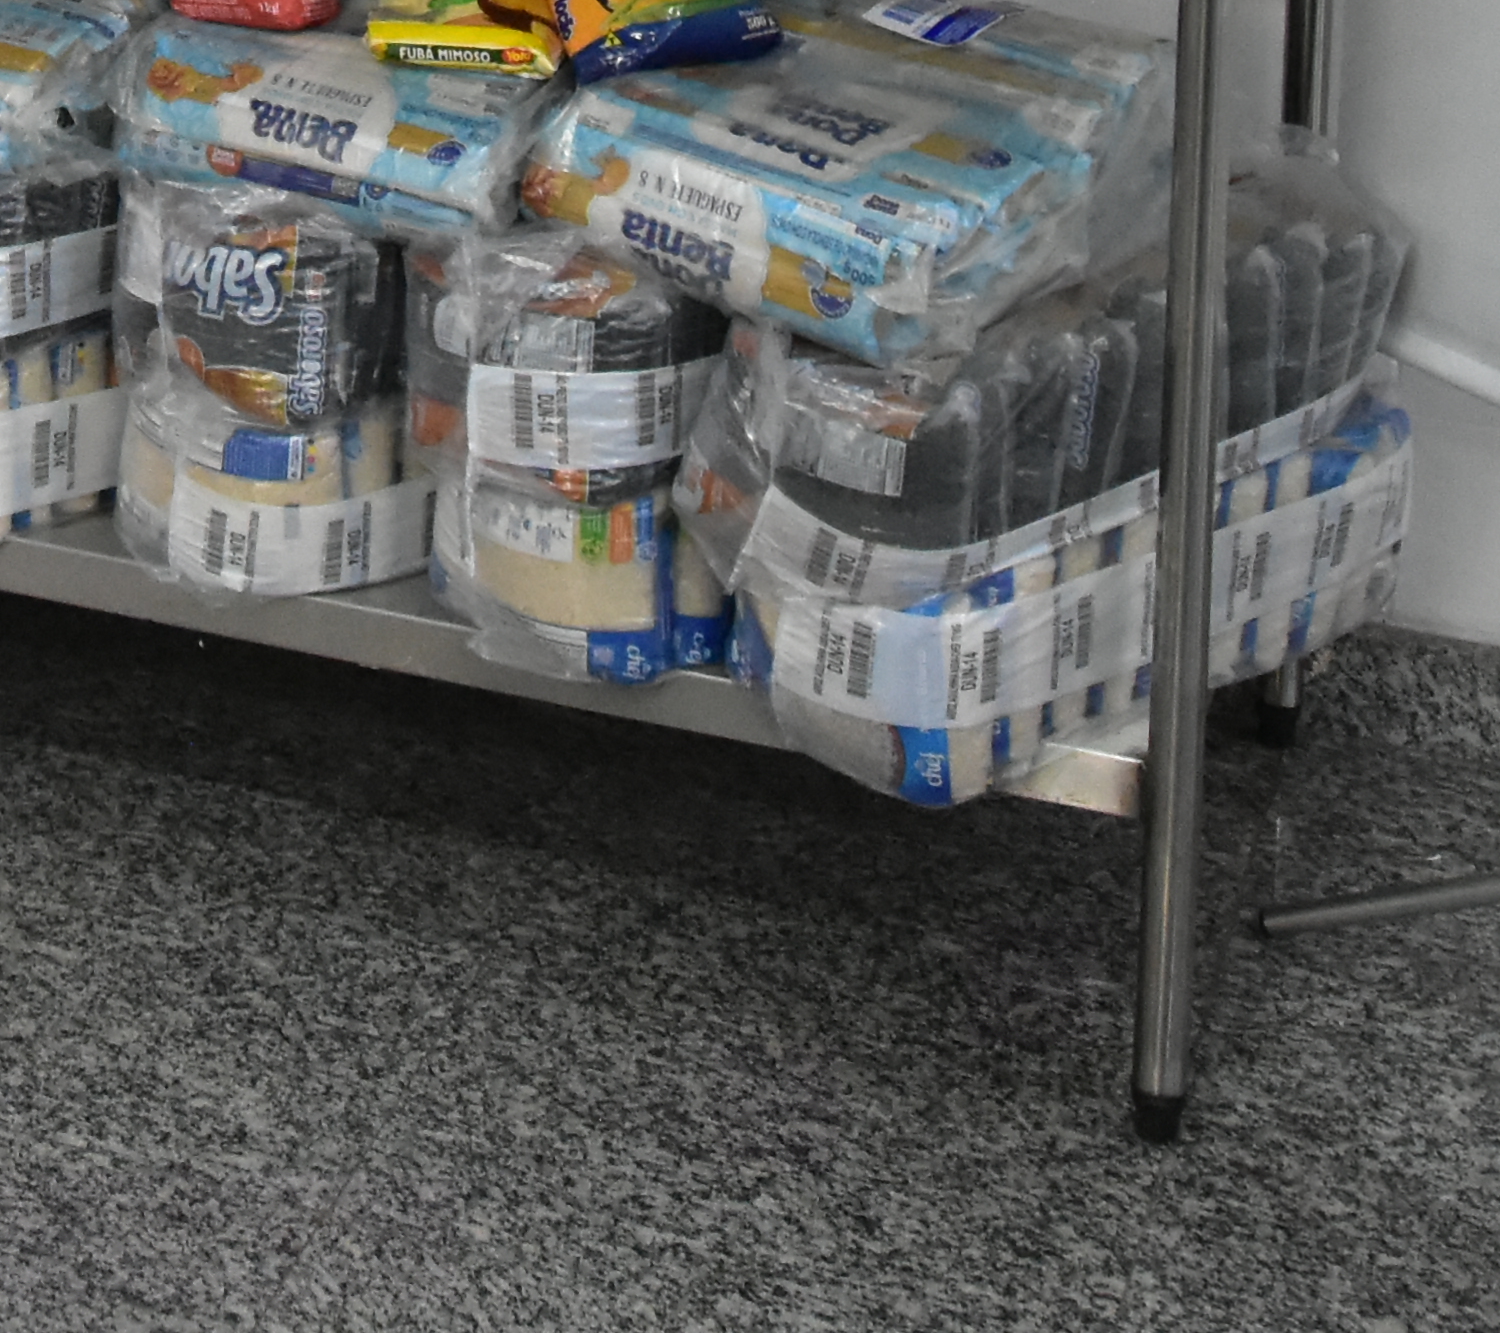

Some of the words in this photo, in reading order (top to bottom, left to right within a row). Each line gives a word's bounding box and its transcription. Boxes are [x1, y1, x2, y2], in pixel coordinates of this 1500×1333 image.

[399, 45, 435, 61] FUBÁ
[437, 48, 491, 63] MIMOSO
[637, 169, 648, 188] 8
[620, 207, 735, 282] Benta
[826, 632, 849, 676] DUN-14
[960, 650, 981, 692] DUN-14
